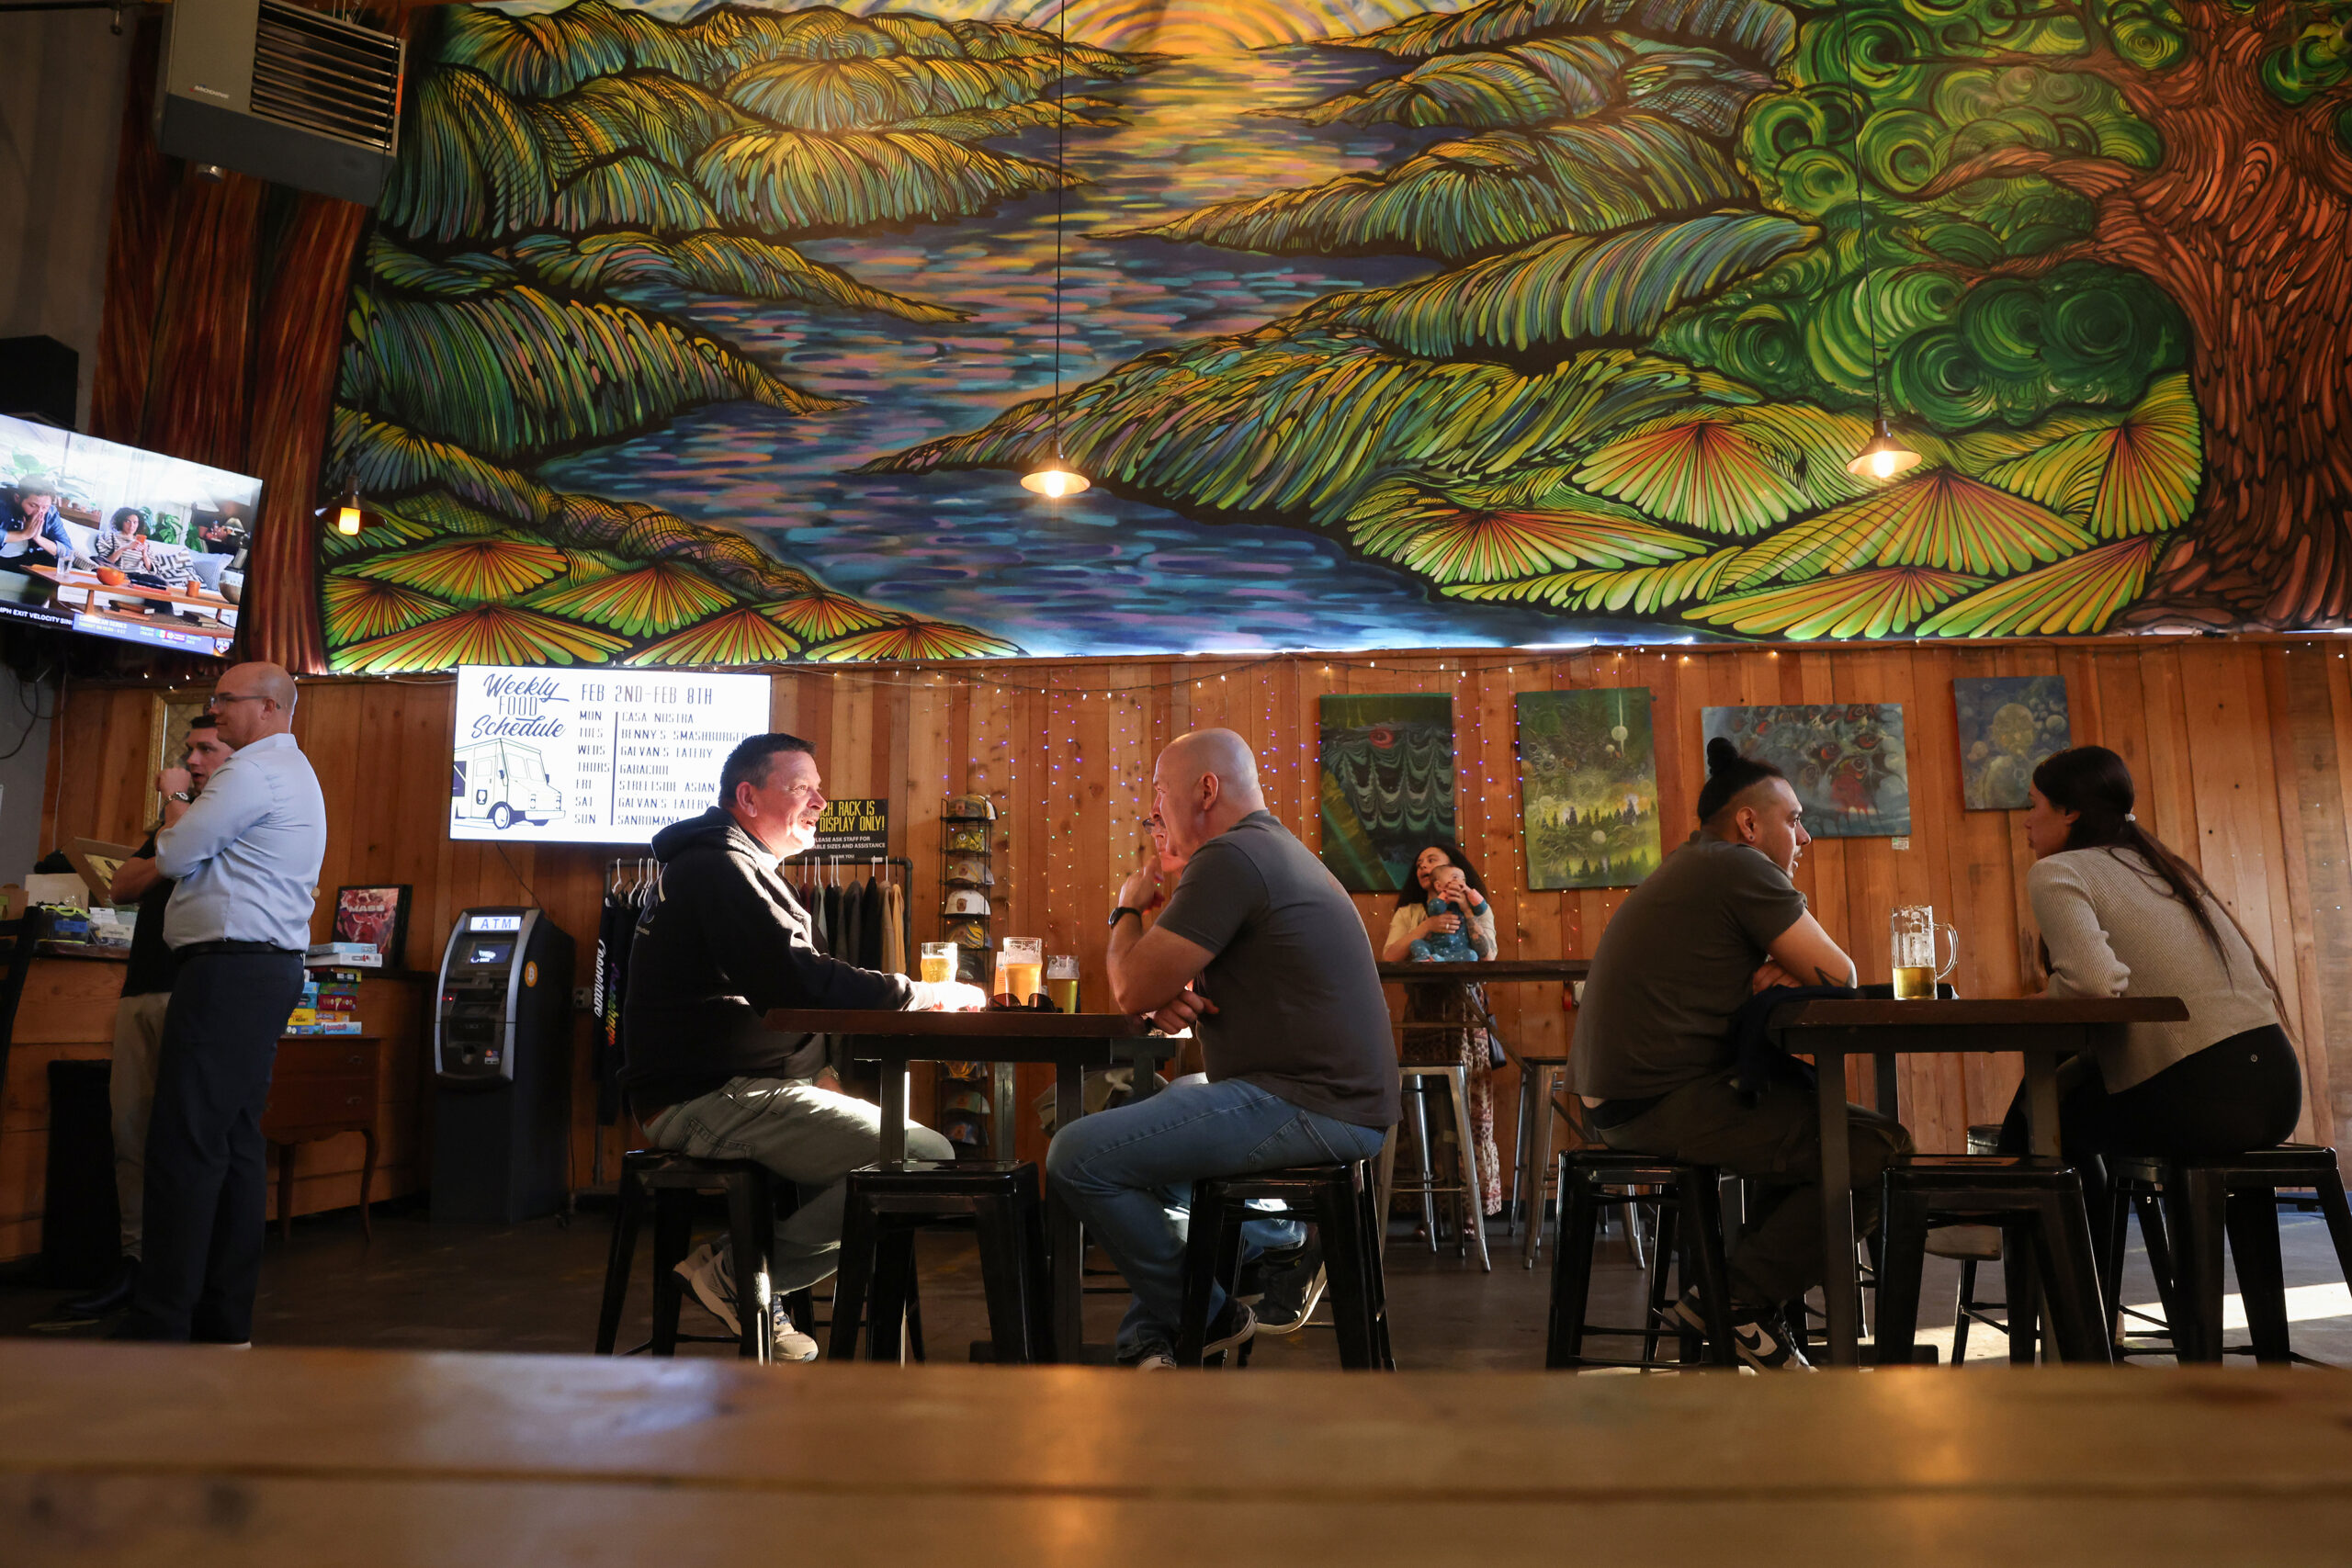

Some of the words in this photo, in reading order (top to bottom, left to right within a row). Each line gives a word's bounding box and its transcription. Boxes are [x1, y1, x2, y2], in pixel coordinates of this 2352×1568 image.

[13, 609, 28, 617] EXIT
[29, 613, 60, 623] VELOCITY
[483, 673, 570, 703] Weekly
[582, 684, 605, 701] FEB
[615, 685, 677, 704] 2ND-FEB
[687, 688, 712, 705] 8TH
[499, 695, 537, 716] FOOD
[580, 710, 602, 720] MON
[622, 712, 647, 722] CASA
[471, 715, 566, 739] Schedule
[580, 728, 603, 738] TUES
[578, 745, 605, 755] WEDS
[578, 762, 610, 773] THURS
[576, 779, 592, 789] FRI
[684, 783, 715, 793] ASIAN
[575, 796, 593, 807] SAT
[838, 800, 861, 816] RACK
[866, 800, 876, 816] IS
[574, 814, 595, 824] SUN
[820, 817, 855, 832] DISPLAY
[859, 816, 885, 831] ONLY!
[481, 919, 512, 929] ATM
